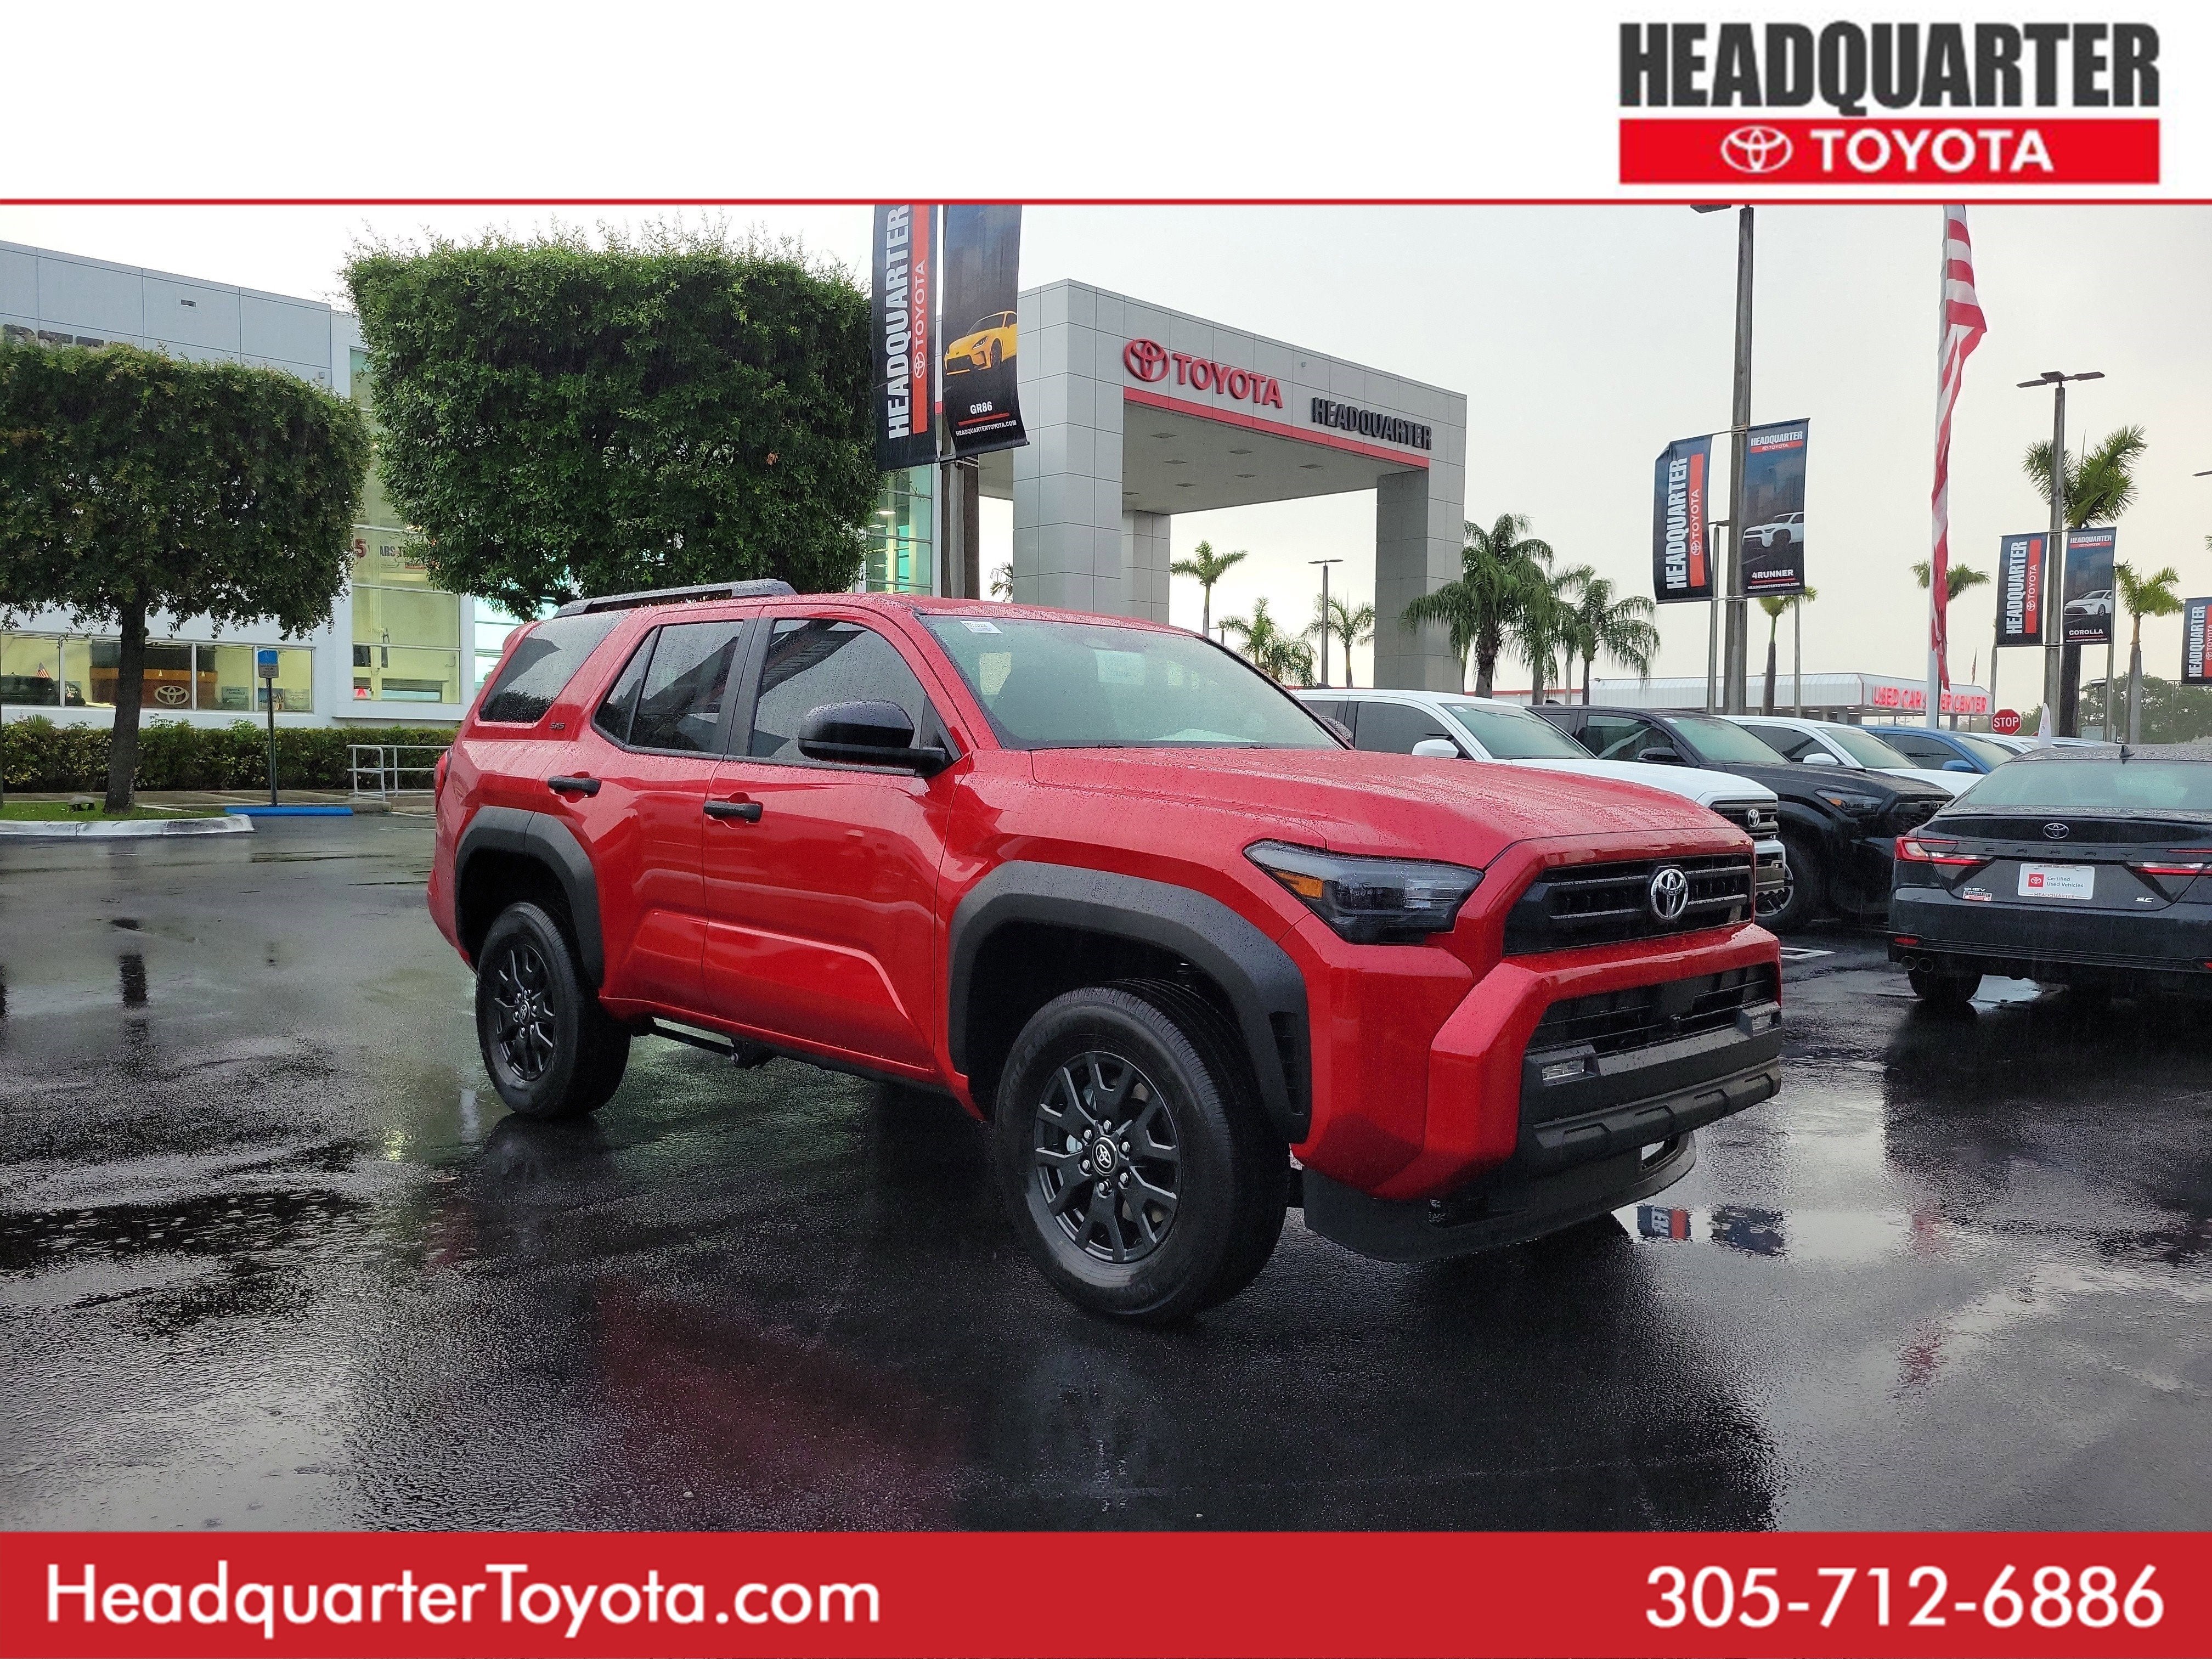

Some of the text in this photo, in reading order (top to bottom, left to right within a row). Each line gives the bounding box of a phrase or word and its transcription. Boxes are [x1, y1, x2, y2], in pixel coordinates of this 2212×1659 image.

[886, 205, 911, 439] HEADQUARTER
[915, 259, 925, 350] TOYOTA
[1172, 353, 1283, 409] TOYOTA
[956, 420, 1017, 436] HEADQUARTERTOYOTA.COM
[970, 401, 992, 414] GR86
[1311, 397, 1432, 450] HEADQUARTER
[1751, 431, 1803, 447] HEADQUARTER
[1666, 458, 1688, 589] HEADQUARTER
[1691, 489, 1700, 540] TOYOTA
[2070, 535, 2112, 544] HEADQUARTER
[1752, 569, 1794, 579] 4RUNNER
[2006, 541, 2028, 634] HEADQUARTER
[2028, 564, 2037, 600] TOYOTA
[2188, 606, 2205, 677] HEADQUARTER
[1872, 686, 1899, 707] USED
[1901, 689, 1921, 709] CAR
[1954, 695, 1987, 713] CENTER
[1994, 717, 2019, 727] STOP
